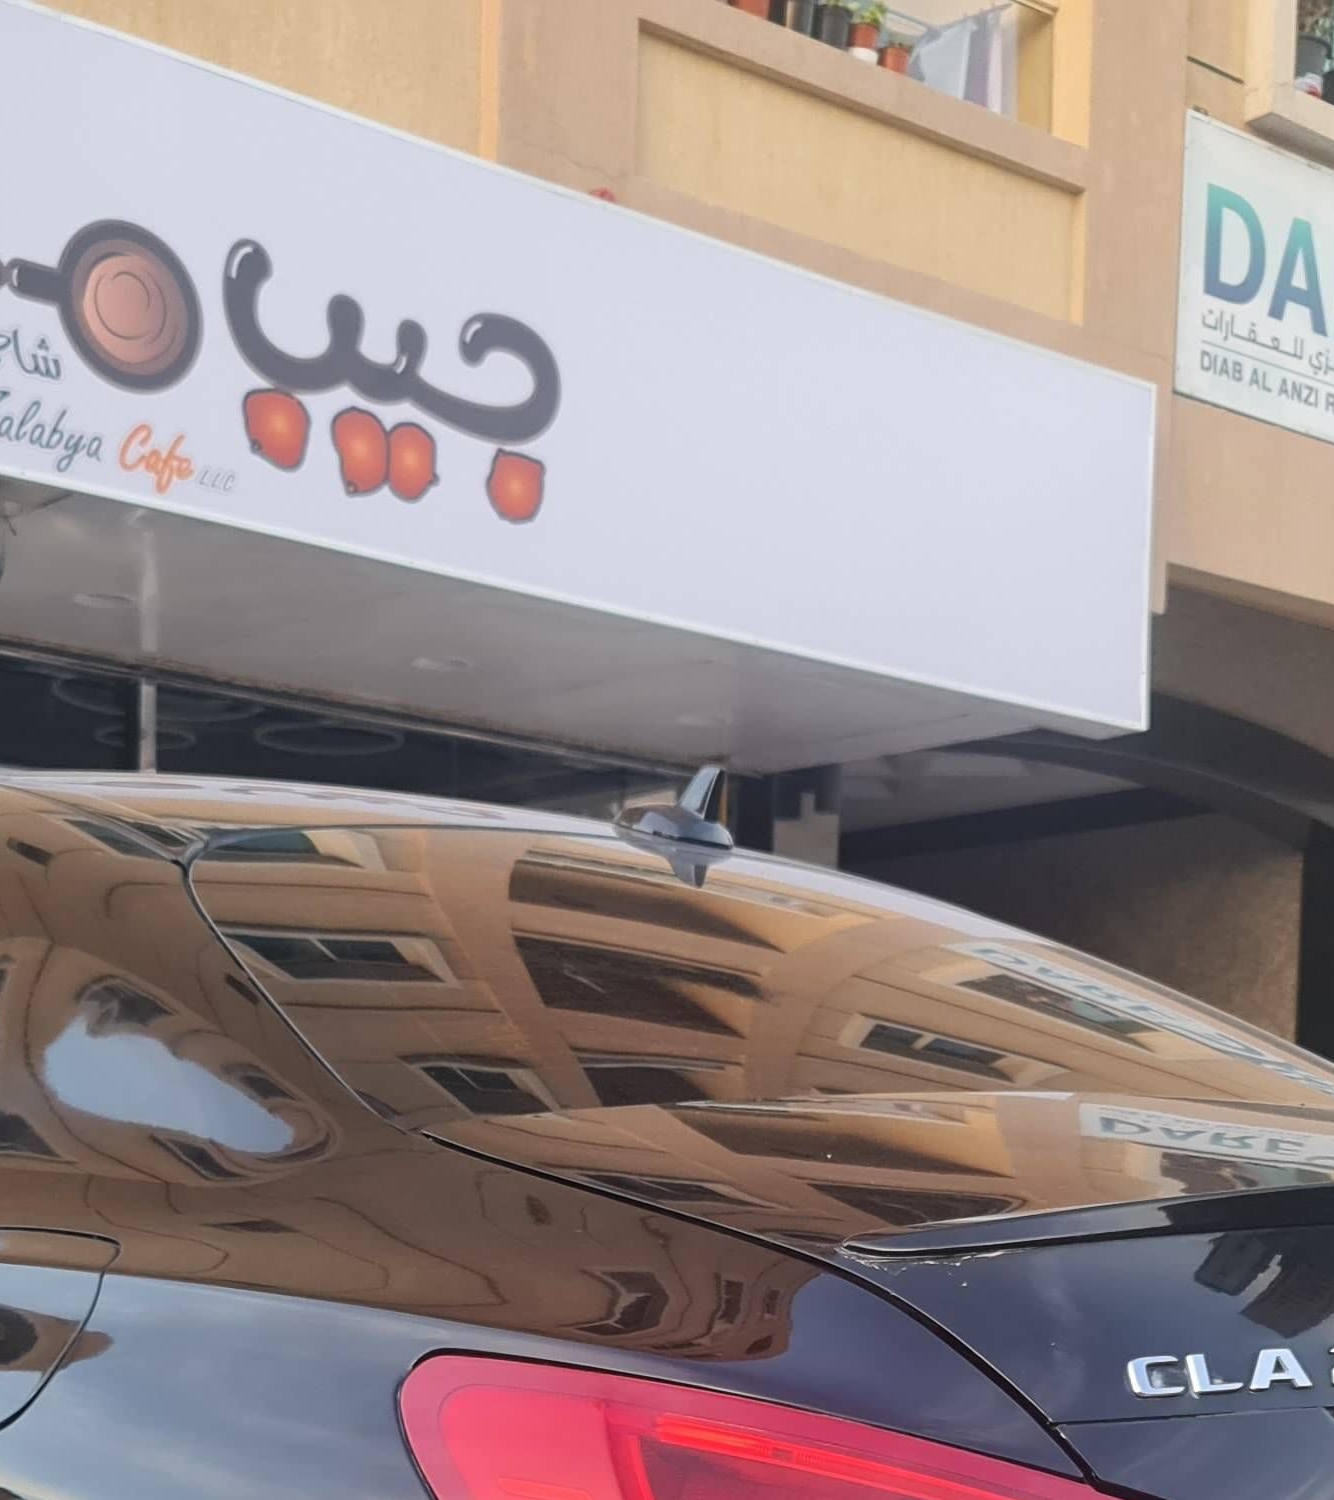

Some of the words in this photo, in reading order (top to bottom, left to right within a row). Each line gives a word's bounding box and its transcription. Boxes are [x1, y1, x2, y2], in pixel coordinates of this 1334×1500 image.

[1201, 307, 1305, 361] للعقارات
[1200, 350, 1244, 384] DIAB
[1248, 366, 1273, 394] AL
[1277, 377, 1319, 409] ANZI
[118, 423, 195, 495] Cafe
[199, 467, 236, 492] LLC
[1126, 1347, 1314, 1398] CLA
